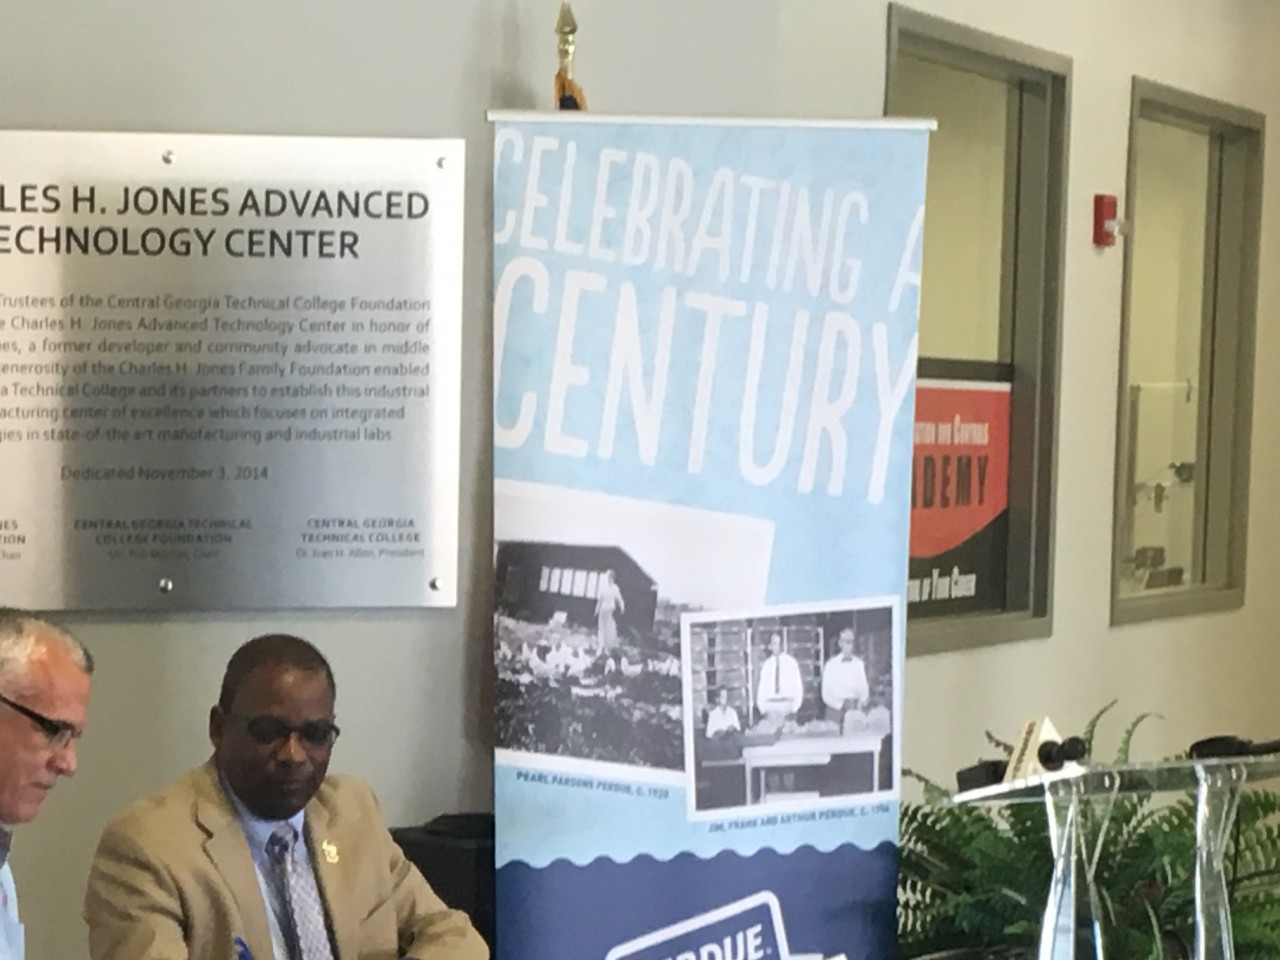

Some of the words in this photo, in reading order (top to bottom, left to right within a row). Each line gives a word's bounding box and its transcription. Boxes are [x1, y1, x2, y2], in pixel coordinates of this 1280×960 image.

[73, 186, 106, 214] H.
[117, 186, 229, 216] JONES
[238, 189, 429, 219] ADVANCED
[493, 128, 868, 305] CELEBRATING
[225, 229, 359, 258] CENTER
[60, 294, 74, 309] of
[79, 295, 102, 309] the
[107, 295, 160, 309] Central
[163, 296, 220, 314] Georgia
[224, 295, 290, 311] Technical
[293, 296, 345, 314] College
[351, 297, 431, 311] Foundation
[11, 316, 64, 330] Charles
[92, 316, 132, 331] Jones
[136, 317, 208, 332] Advanced
[214, 318, 294, 335] Technology
[299, 319, 346, 333] Center
[352, 319, 364, 333] in
[369, 319, 410, 333] honor
[416, 319, 431, 333] of
[29, 342, 36, 352] a
[42, 338, 92, 353] former
[98, 338, 168, 356] developer
[175, 340, 201, 354] and
[207, 341, 288, 356] community
[293, 340, 358, 354] advocate
[364, 340, 377, 354] in
[382, 340, 430, 355] middle
[73, 361, 88, 374] of
[92, 361, 115, 375] the
[118, 361, 175, 375] Charles
[196, 362, 235, 376] Jones
[239, 362, 285, 380] Family
[290, 362, 370, 376] Foundation
[374, 362, 430, 376] enabled
[493, 256, 919, 505] CENTURY
[12, 382, 79, 397] Technical
[82, 383, 135, 400] College
[139, 383, 166, 397] and
[170, 384, 185, 397] its
[189, 385, 248, 400] partners
[252, 385, 267, 397] to
[271, 384, 333, 397] establish
[336, 384, 361, 397] this
[365, 384, 430, 397] industrial
[62, 407, 108, 419] center
[112, 405, 127, 419] of
[131, 405, 204, 419] excellence
[208, 407, 250, 420] which
[254, 406, 306, 419] focuses
[310, 409, 328, 419] on
[332, 407, 405, 422] integrated
[27, 427, 40, 441] in
[134, 430, 152, 441] art
[157, 428, 261, 445] manufacturing
[266, 428, 291, 441] and
[295, 428, 360, 441] industrial
[60, 466, 134, 480] Dedicated
[138, 468, 212, 480] November
[234, 466, 268, 480] 2014
[912, 454, 988, 509] DEMY
[307, 518, 360, 529] CENTRAL
[363, 518, 415, 529] GEORGIA
[302, 533, 364, 543] TECHNICAL
[368, 533, 420, 543] COLLEGE
[516, 770, 549, 784] PEARL
[551, 775, 594, 790] PARSONS
[728, 818, 757, 830] FRANK
[760, 816, 778, 827] AND
[781, 811, 817, 825] ARTHUR
